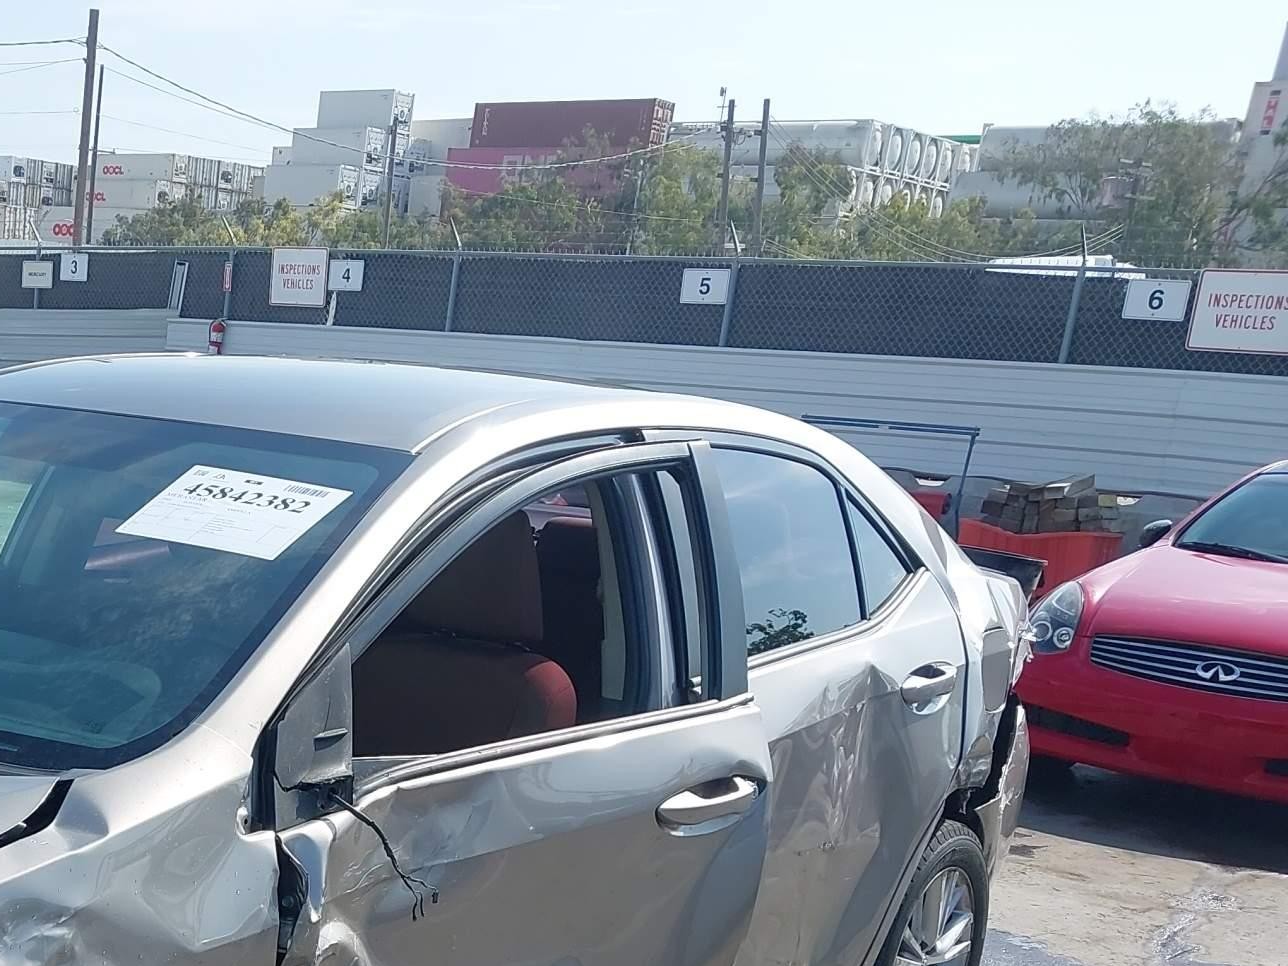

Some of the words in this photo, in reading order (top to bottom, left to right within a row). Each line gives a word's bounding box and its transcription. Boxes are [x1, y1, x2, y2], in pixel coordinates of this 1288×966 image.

[103, 166, 124, 175] OOCL
[70, 260, 78, 274] 3
[278, 263, 321, 276] INSPECTIONS
[341, 268, 351, 283] 4
[282, 278, 314, 290] VEHICLES
[699, 277, 712, 295] 5
[1148, 289, 1165, 311] 6
[1215, 313, 1277, 330] VEHICLES
[184, 482, 312, 514] 45842382
